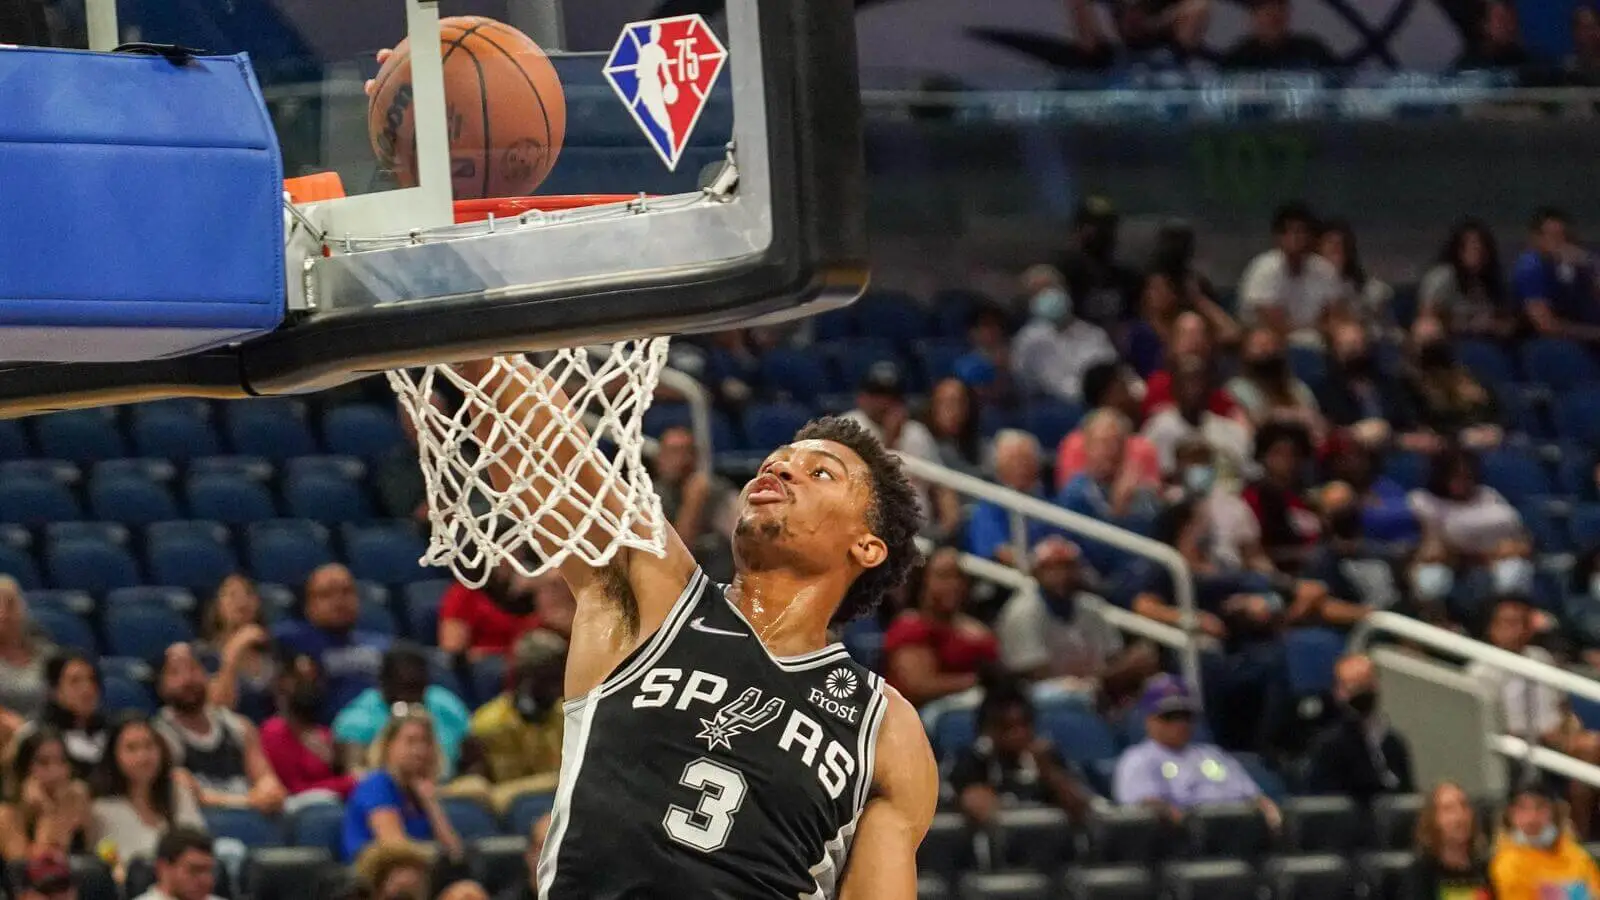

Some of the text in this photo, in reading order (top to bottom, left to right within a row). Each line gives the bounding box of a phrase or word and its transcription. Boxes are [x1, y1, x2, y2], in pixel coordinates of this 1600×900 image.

[673, 38, 700, 82] 75
[808, 688, 858, 723] Frost
[662, 757, 748, 853] 3
